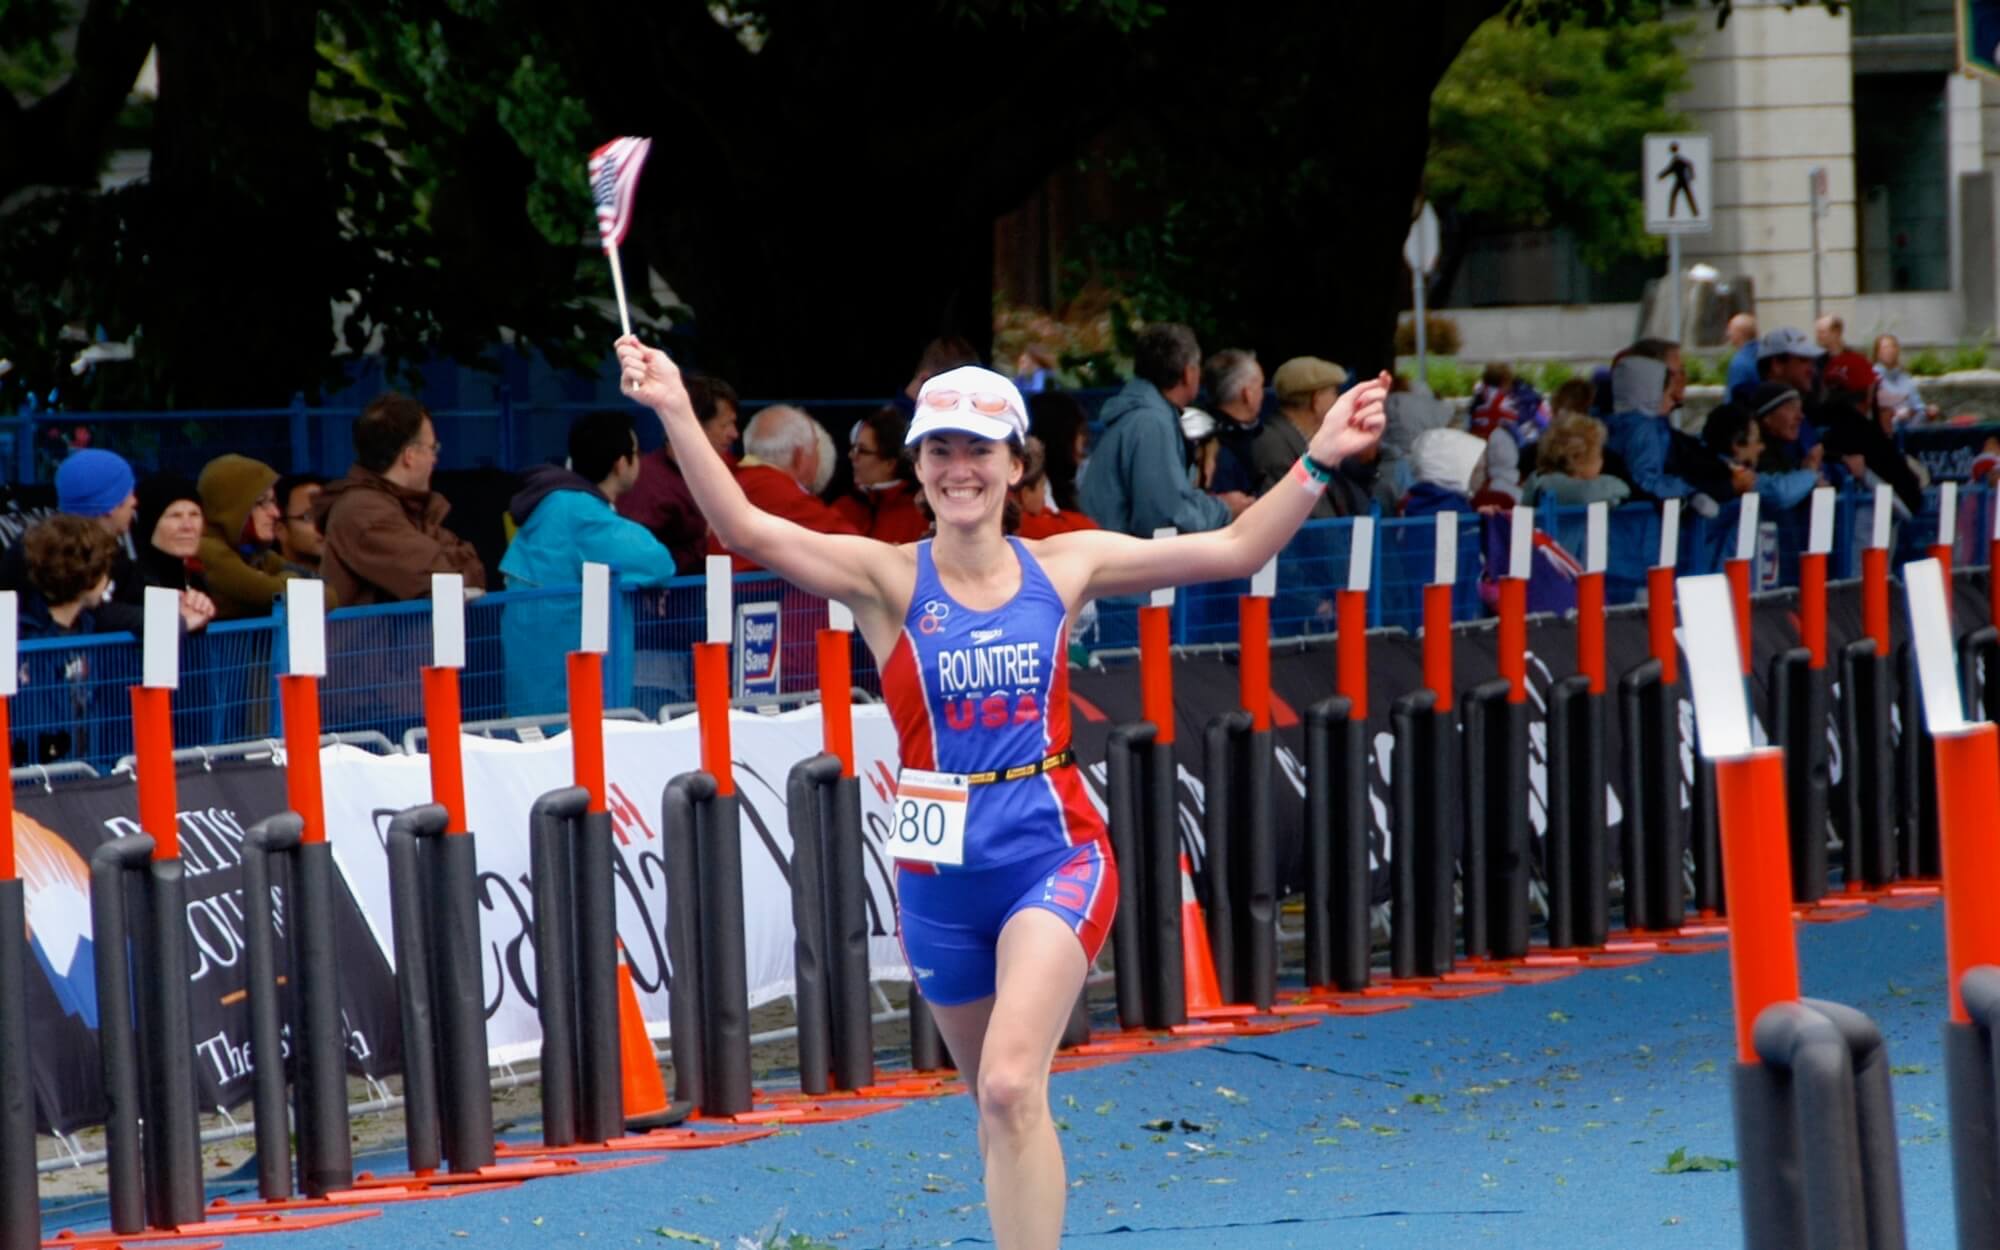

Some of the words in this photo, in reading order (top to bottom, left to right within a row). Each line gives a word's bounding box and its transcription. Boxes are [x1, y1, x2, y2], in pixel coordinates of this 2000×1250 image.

[938, 642, 1041, 692] ROUNTREE
[945, 695, 1041, 731] USA
[195, 1030, 253, 1085] The
